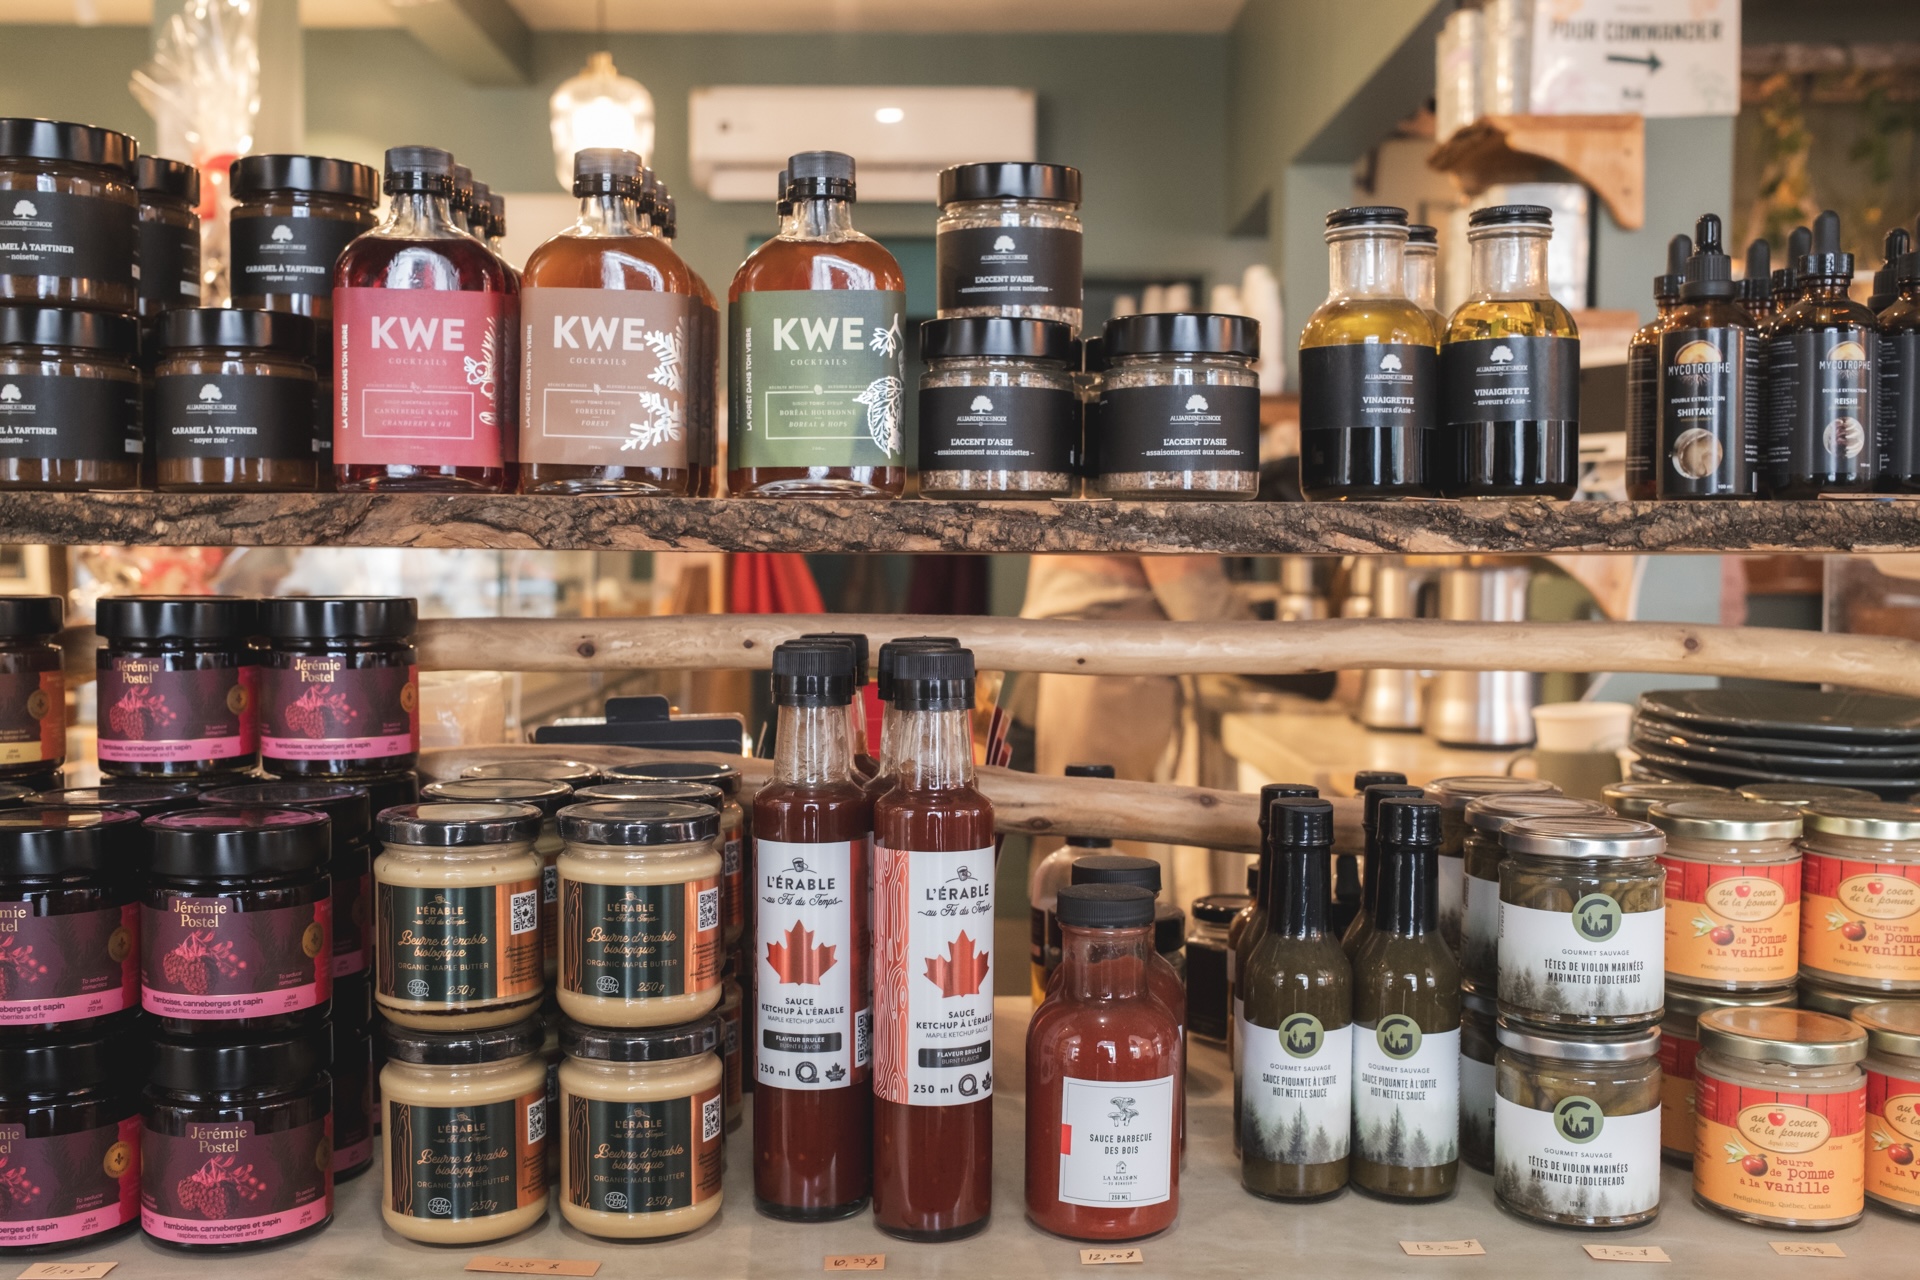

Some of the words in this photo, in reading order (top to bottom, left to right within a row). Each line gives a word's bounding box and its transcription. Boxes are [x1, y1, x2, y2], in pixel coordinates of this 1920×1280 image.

[1605, 21, 1722, 41] COMMANDER
[21, 242, 28, 251] À
[29, 243, 74, 253] TARTINER
[11, 253, 39, 261] noisette
[246, 265, 278, 274] CARAMEL
[285, 265, 326, 274] TARTINER
[975, 276, 1008, 284] L'ACCENT
[1010, 275, 1034, 283] D'ASIE
[372, 316, 464, 352] KWE
[554, 316, 644, 352] KWE
[774, 317, 864, 352] KWE
[388, 358, 448, 366] COCKTAILS
[570, 357, 627, 366] COCKTAILS
[1820, 360, 1870, 370] MYCOTROPHE
[1668, 362, 1730, 376] MYCOTROPHE
[1474, 387, 1530, 397] VINAIGRETTE
[1362, 396, 1414, 405] VINAIGRETTE
[1677, 408, 1717, 417] SHIITAKE
[342, 418, 348, 428] LA
[526, 418, 532, 428] LA
[746, 420, 752, 431] LA
[172, 426, 206, 435] CARAMEL
[206, 425, 214, 434] À
[214, 426, 258, 436] TARTINER
[194, 437, 212, 446] noyer
[951, 438, 986, 446] L'ACCENT
[988, 438, 1013, 446] D'ASIE
[1164, 438, 1200, 446] L'ACCENT
[1203, 438, 1227, 446] D'ASIE
[294, 659, 340, 670] Jérémie
[122, 672, 152, 684] Postel
[301, 670, 334, 682] Postel
[767, 876, 835, 890] L'ÉRABLE
[926, 884, 989, 900] L'ÉRABLE
[796, 896, 806, 906] du
[174, 900, 226, 914] Jérémie
[416, 906, 464, 916] L'ÉRABLE
[180, 914, 219, 928] Postel
[398, 930, 439, 945] Beurre
[440, 934, 488, 946] d'érable
[414, 946, 466, 961] biologique
[398, 963, 430, 971] ORGANIC
[1544, 958, 1566, 970] TÊTES
[1569, 962, 1578, 971] DE
[1582, 962, 1608, 972] VIOLON
[1612, 960, 1644, 972] MARINÉES
[1548, 972, 1591, 984] MARINATED
[1594, 974, 1640, 984] FIDDLEHEADS
[184, 998, 232, 1008] canneberges
[244, 996, 264, 1006] sapin
[785, 998, 814, 1006] SAUCE
[762, 1004, 796, 1016] KETCHUP
[796, 1006, 802, 1016] À
[806, 1006, 844, 1016] L'ÉRABLE
[948, 1009, 974, 1019] SAUCE
[916, 1020, 958, 1030] KETCHUP
[960, 1018, 966, 1028] À
[968, 1013, 992, 1028] L'ÉRABLE
[776, 1035, 801, 1043] FLAVEUR
[802, 1035, 825, 1043] BRULÉE
[760, 1062, 774, 1075] 250
[779, 1068, 790, 1076] ml
[1262, 1073, 1280, 1085] SAUCE
[1282, 1076, 1312, 1087] PIQUANTE
[1318, 1074, 1336, 1086] L'ORTIE
[1272, 1088, 1284, 1097] HOT
[1286, 1088, 1308, 1098] NETTLE
[1309, 1088, 1327, 1098] SAUCE
[616, 1120, 662, 1129] L'ÉRABLE
[1751, 1114, 1766, 1124] au
[1788, 1120, 1818, 1128] coeur
[190, 1126, 247, 1140] Jérémie
[1749, 1124, 1761, 1134] de
[1764, 1126, 1775, 1136] la
[1779, 1128, 1820, 1138] pomme
[1090, 1134, 1114, 1143] SAUCE
[1117, 1133, 1152, 1143] BARBECUE
[199, 1140, 240, 1153] Postel
[594, 1144, 636, 1159] Beurre
[640, 1144, 684, 1159] d'érable
[1122, 1146, 1138, 1154] BOIS
[612, 1160, 664, 1173] biologique
[1776, 1156, 1814, 1167] beurre
[1770, 1168, 1782, 1177] de
[1788, 1168, 1834, 1180] pomme
[1749, 1179, 1760, 1188] la
[1764, 1180, 1830, 1194] vanille
[164, 1220, 199, 1232] framboises,
[200, 1222, 250, 1234] canneberges
[262, 1218, 282, 1228] sapin
